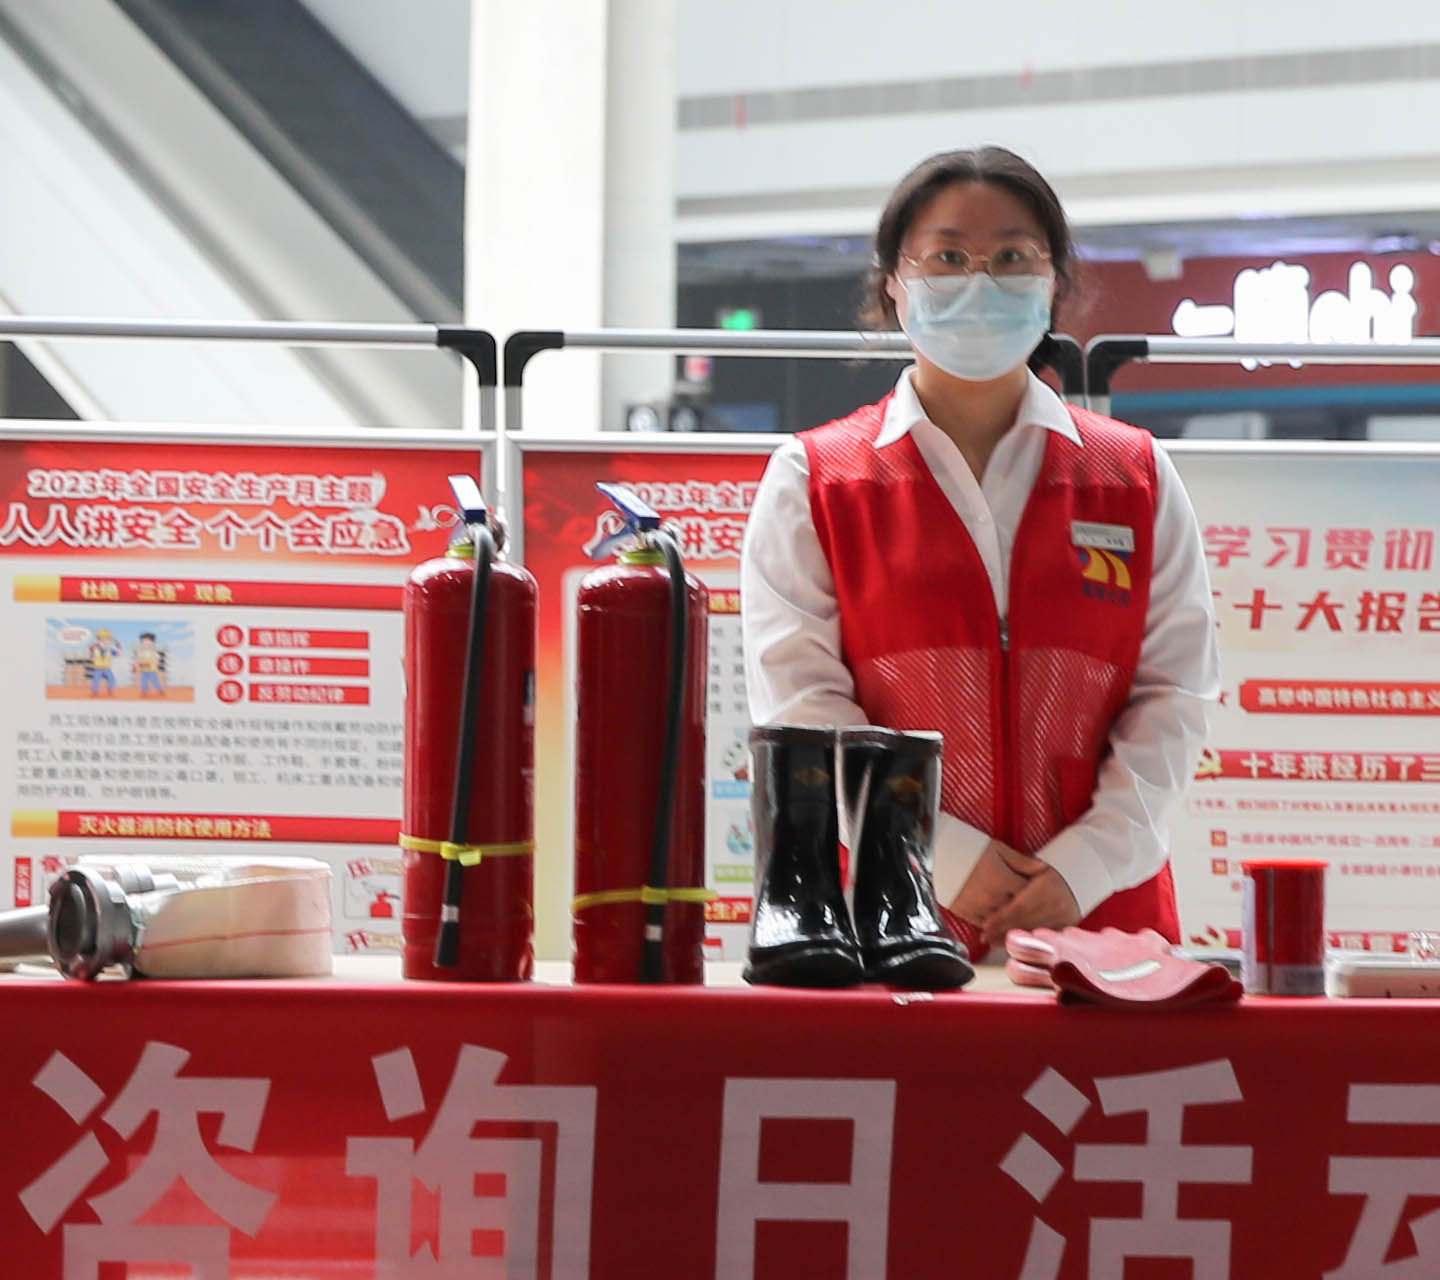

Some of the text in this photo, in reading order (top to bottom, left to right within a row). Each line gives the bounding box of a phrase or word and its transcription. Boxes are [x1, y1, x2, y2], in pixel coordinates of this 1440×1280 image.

[27, 471, 376, 506] 2023年全国安全生产月主题
[207, 511, 411, 554] 个个会应急
